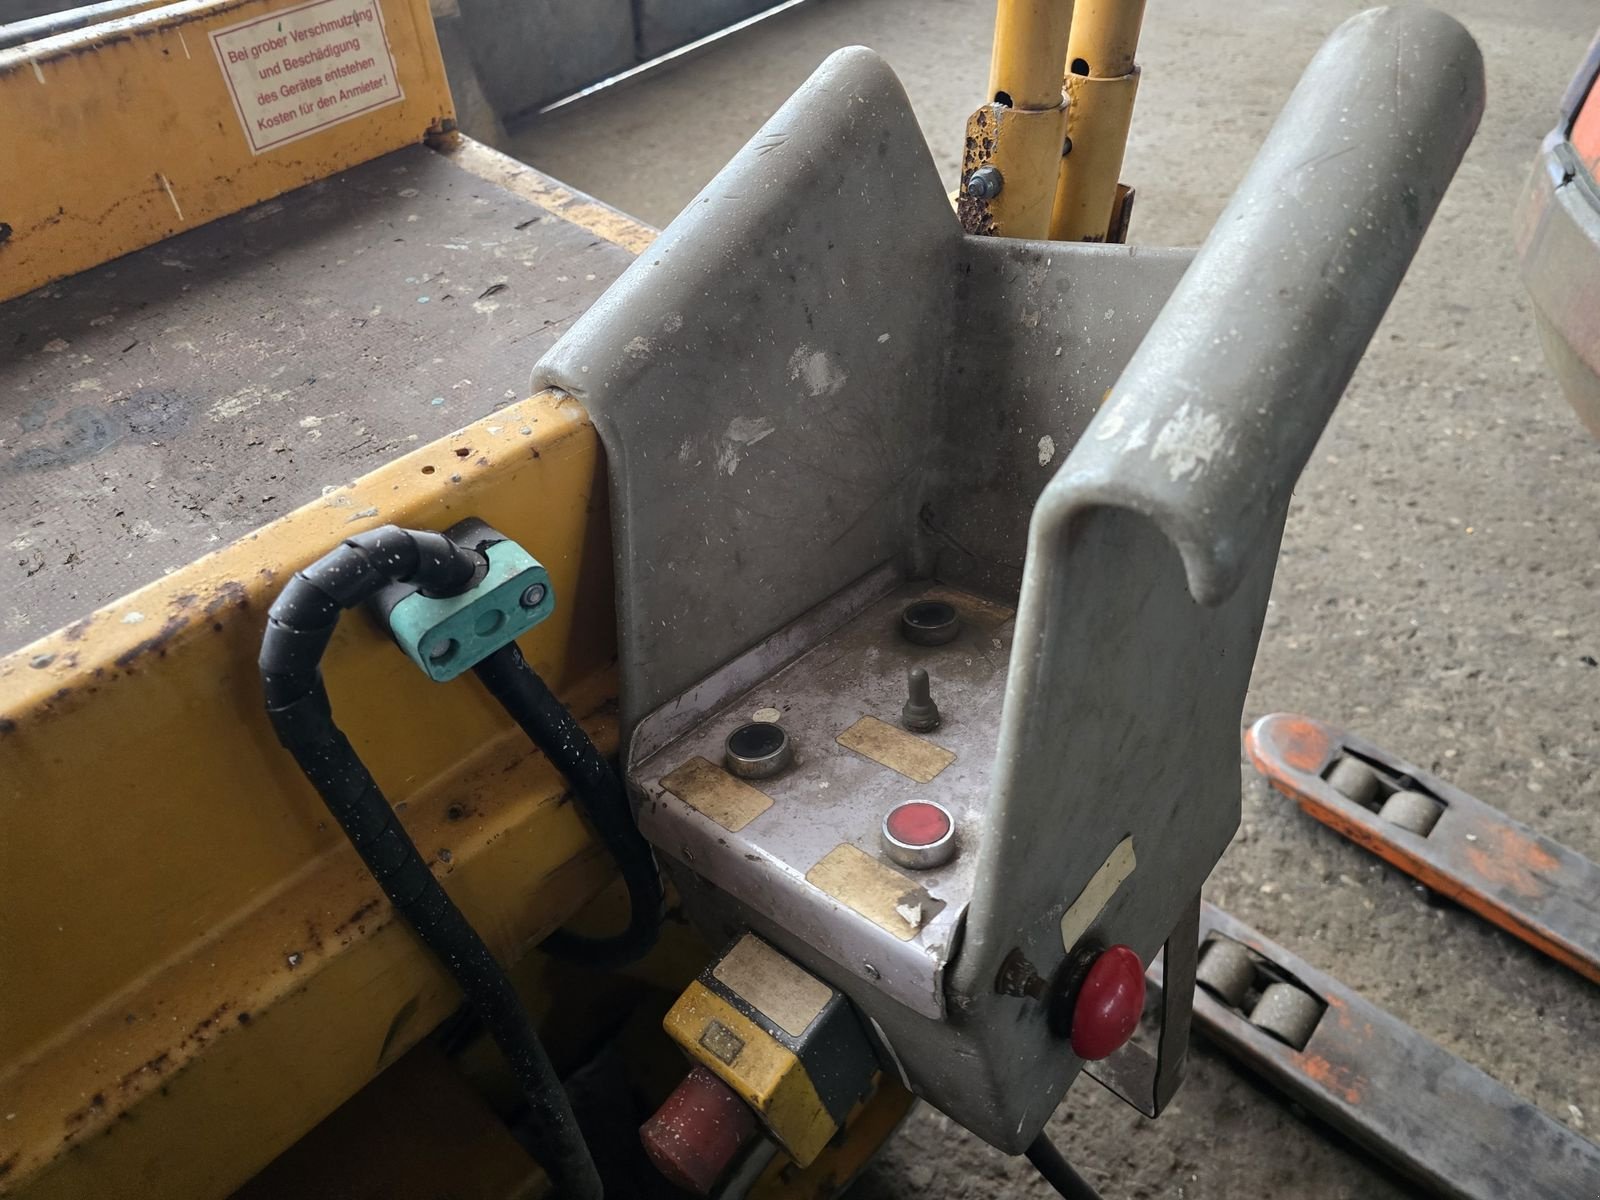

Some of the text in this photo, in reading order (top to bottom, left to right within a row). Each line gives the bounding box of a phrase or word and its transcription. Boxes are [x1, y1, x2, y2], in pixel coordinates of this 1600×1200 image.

[227, 8, 373, 64] Bei grober Verschmutzung
[259, 37, 360, 79] und Beschädigung
[257, 57, 375, 106] des Gerätes entstehen
[257, 74, 388, 131] Kosten für den Anmieter!
